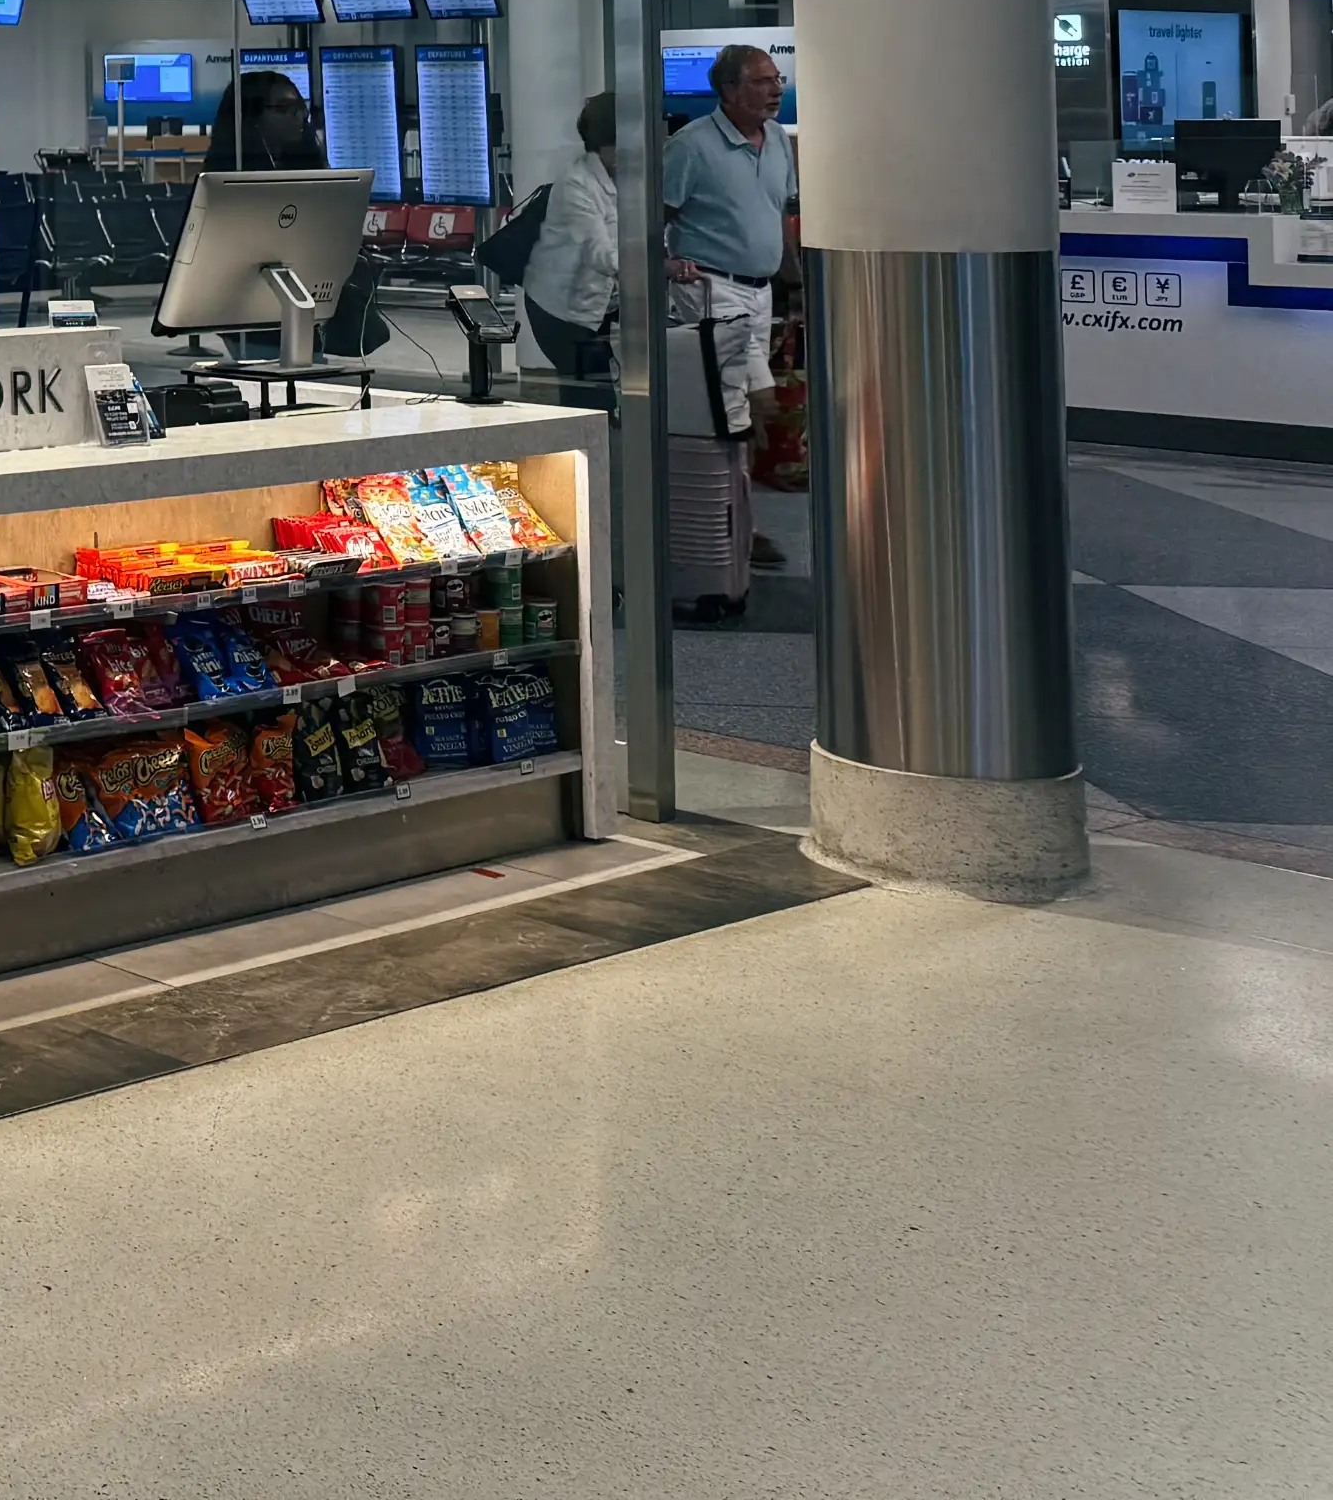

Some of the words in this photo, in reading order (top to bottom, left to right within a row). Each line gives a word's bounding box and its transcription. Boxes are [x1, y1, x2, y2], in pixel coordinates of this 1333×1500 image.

[1148, 23, 1173, 39] travel
[1175, 23, 1203, 41] lighter
[333, 51, 374, 60] DEPARTURES
[427, 51, 466, 59] DEPARTURES
[1054, 42, 1090, 59] harge
[244, 54, 288, 62] DEPARTURES
[1055, 55, 1090, 66] tation
[34, 596, 56, 607] KIND
